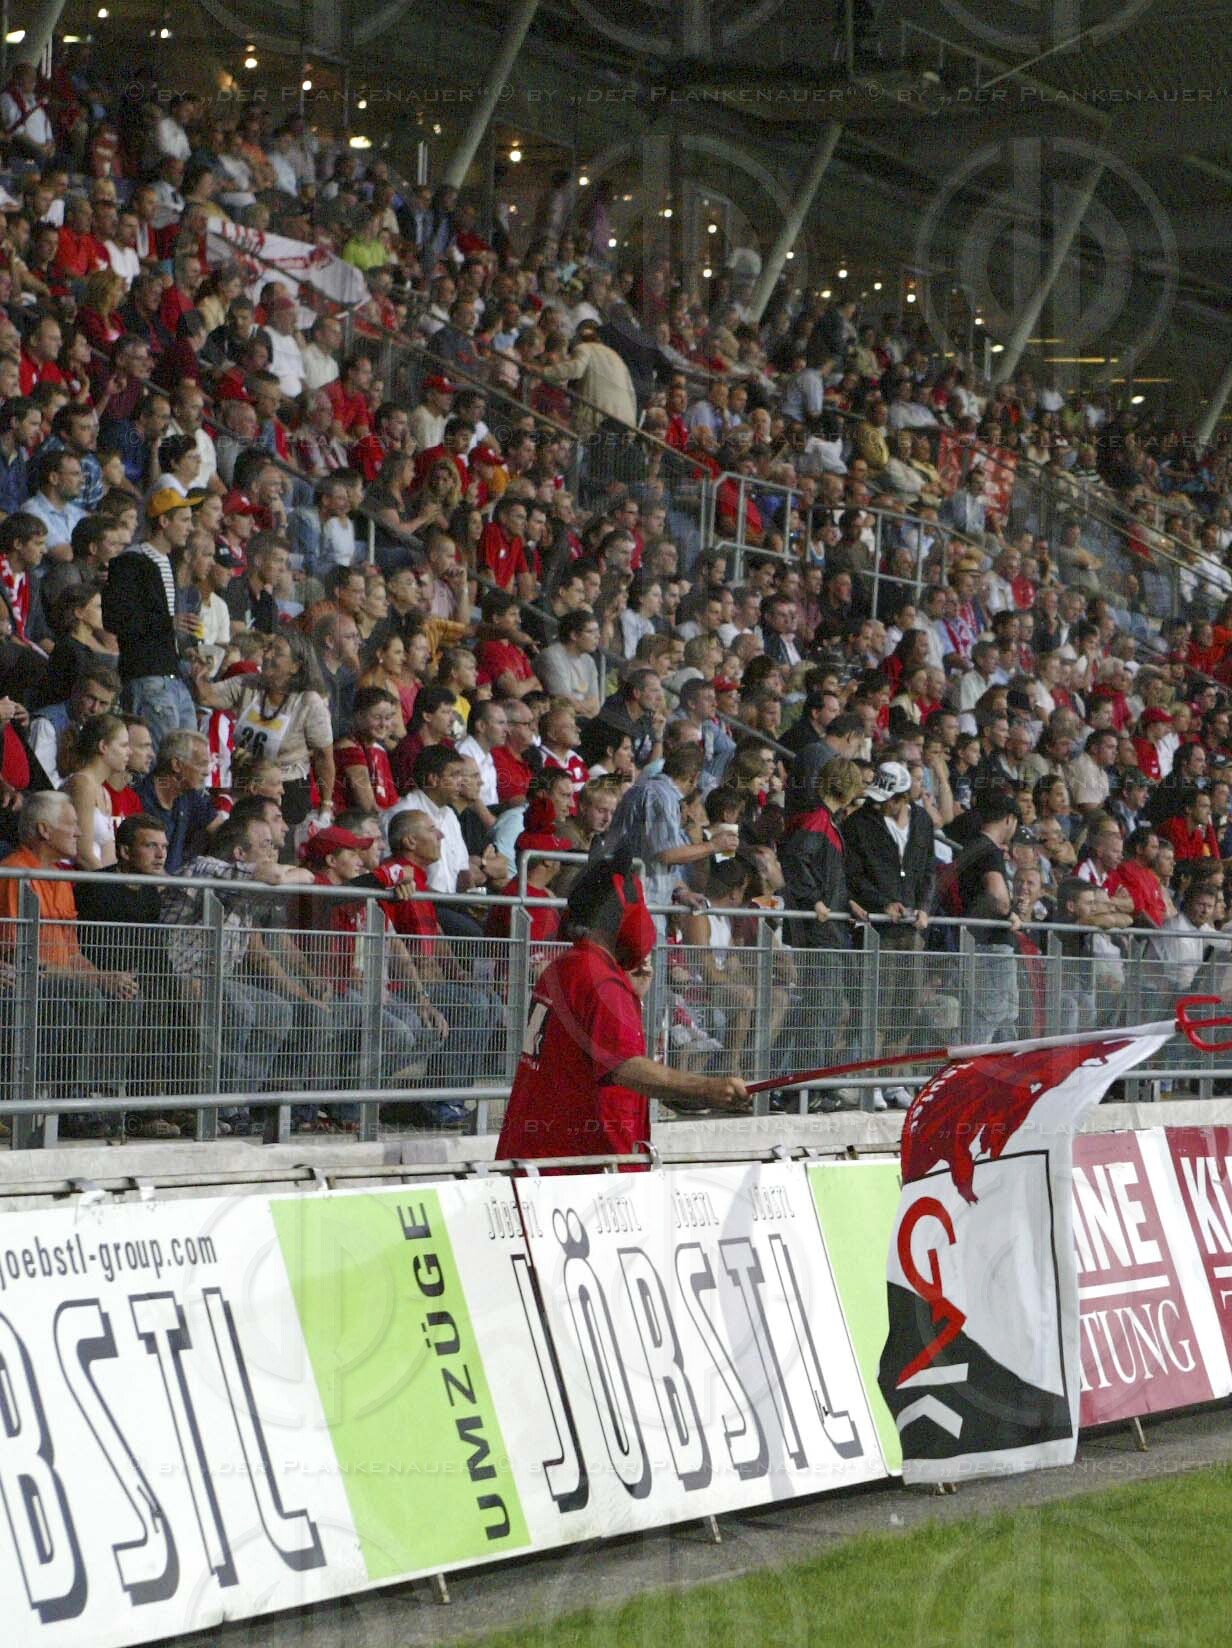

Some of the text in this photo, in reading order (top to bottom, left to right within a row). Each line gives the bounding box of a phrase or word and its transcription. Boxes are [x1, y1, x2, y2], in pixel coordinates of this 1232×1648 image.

[1072, 1162, 1163, 1273] INE
[397, 1201, 511, 1541] UMZÜGE
[509, 1207, 865, 1513] JÖBSTL
[1080, 1299, 1196, 1392] TUNG
